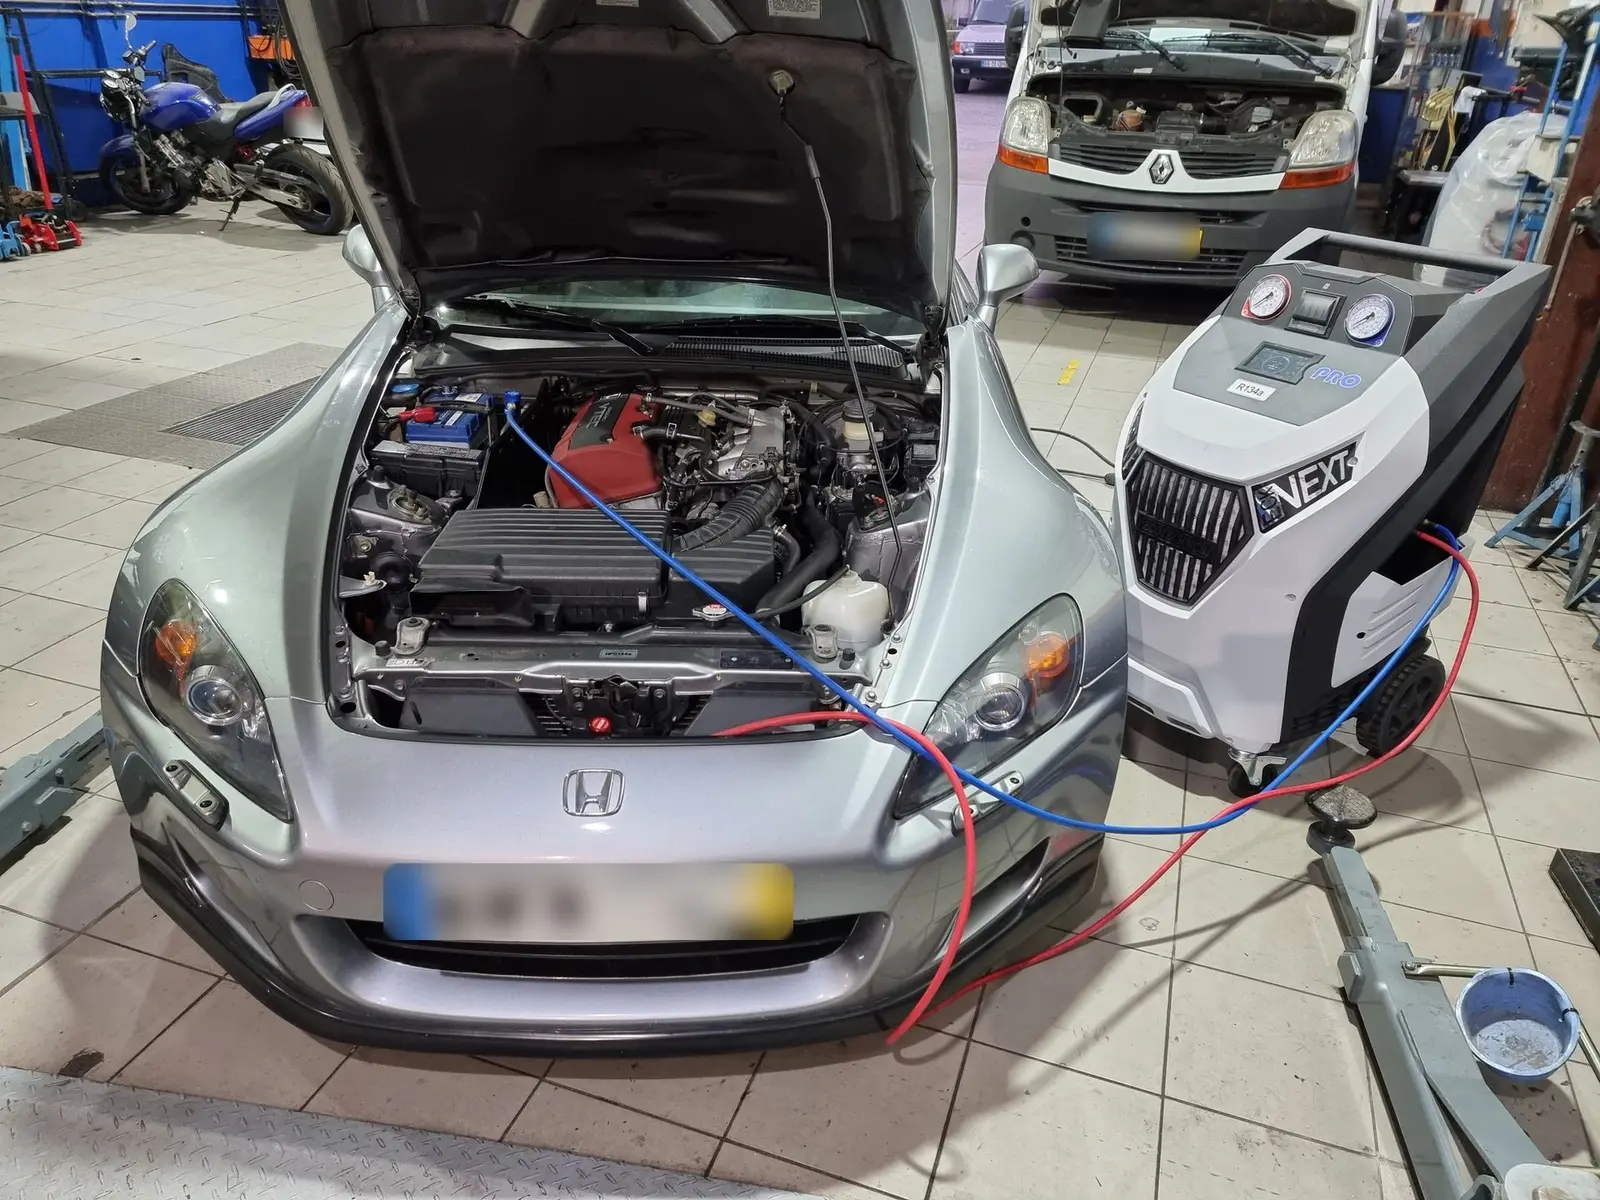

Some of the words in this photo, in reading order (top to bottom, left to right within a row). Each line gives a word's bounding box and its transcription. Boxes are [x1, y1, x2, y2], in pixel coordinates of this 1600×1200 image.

[1310, 366, 1362, 389] PRO
[1235, 382, 1265, 397] R134a
[1263, 449, 1349, 515] NEXT
